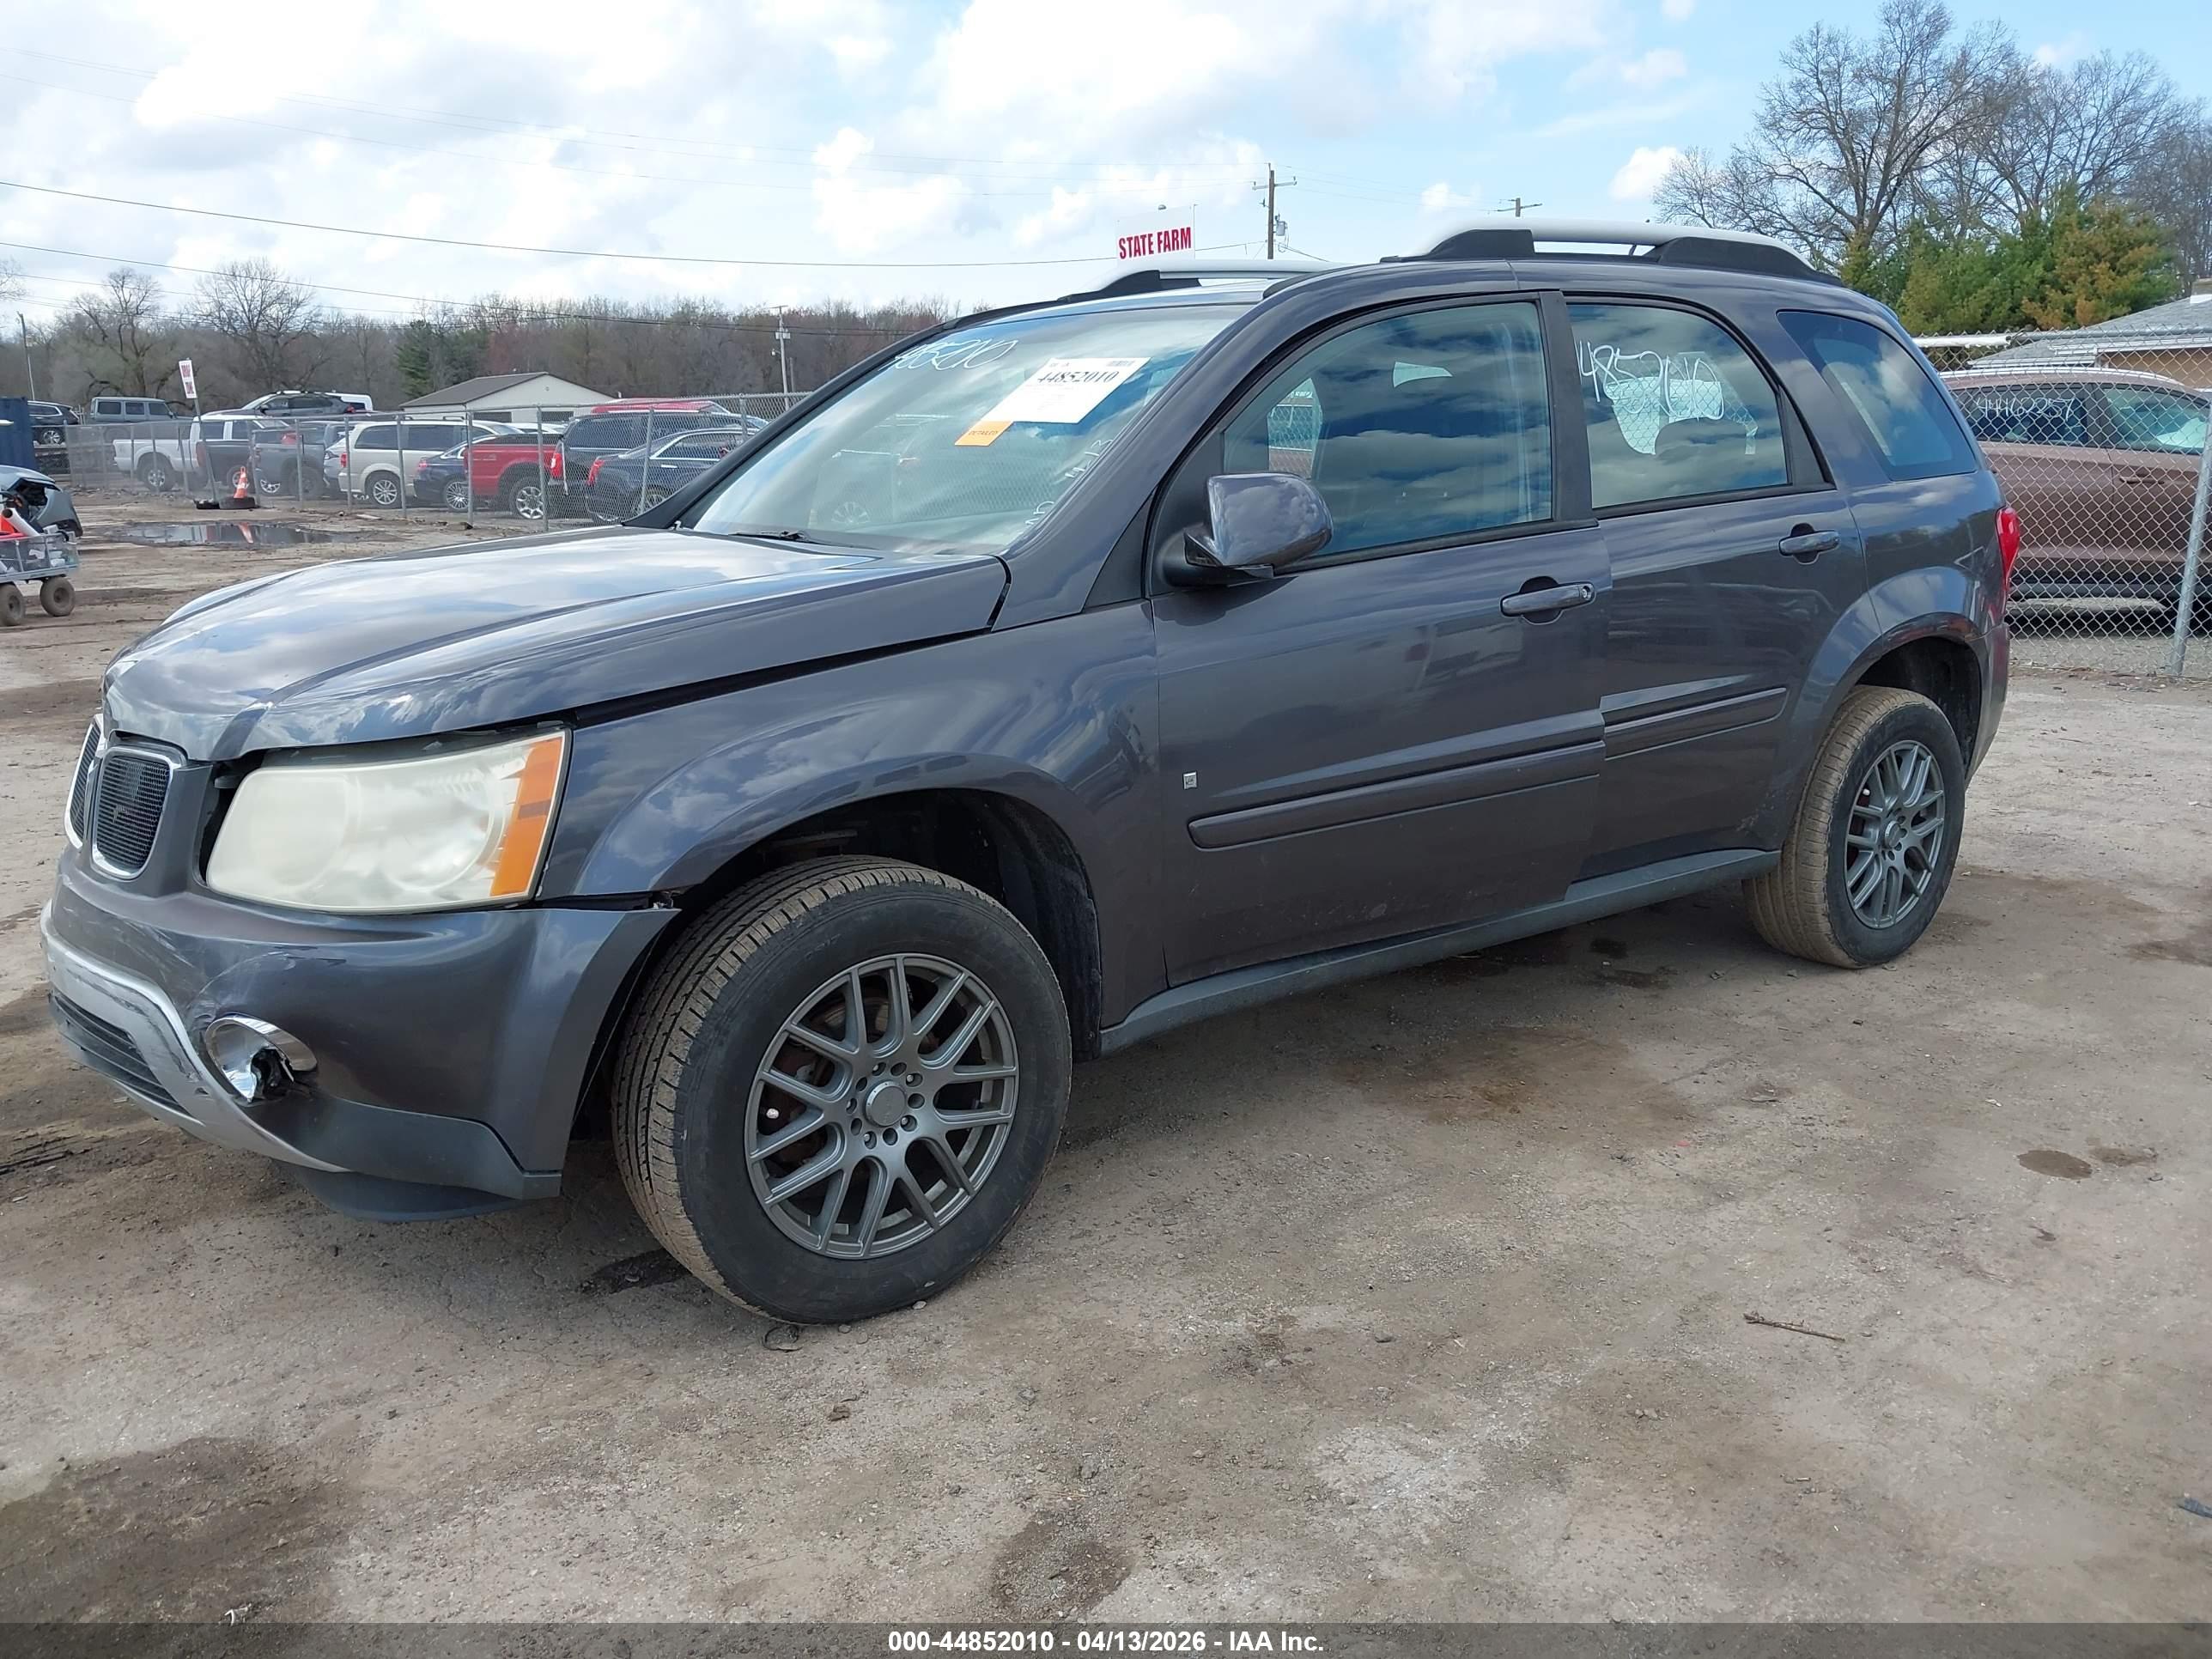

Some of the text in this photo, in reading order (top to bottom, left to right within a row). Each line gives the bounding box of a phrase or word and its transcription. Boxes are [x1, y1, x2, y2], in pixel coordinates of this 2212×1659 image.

[1119, 227, 1192, 259] STATE FARM
[1037, 371, 1120, 383] 44852010
